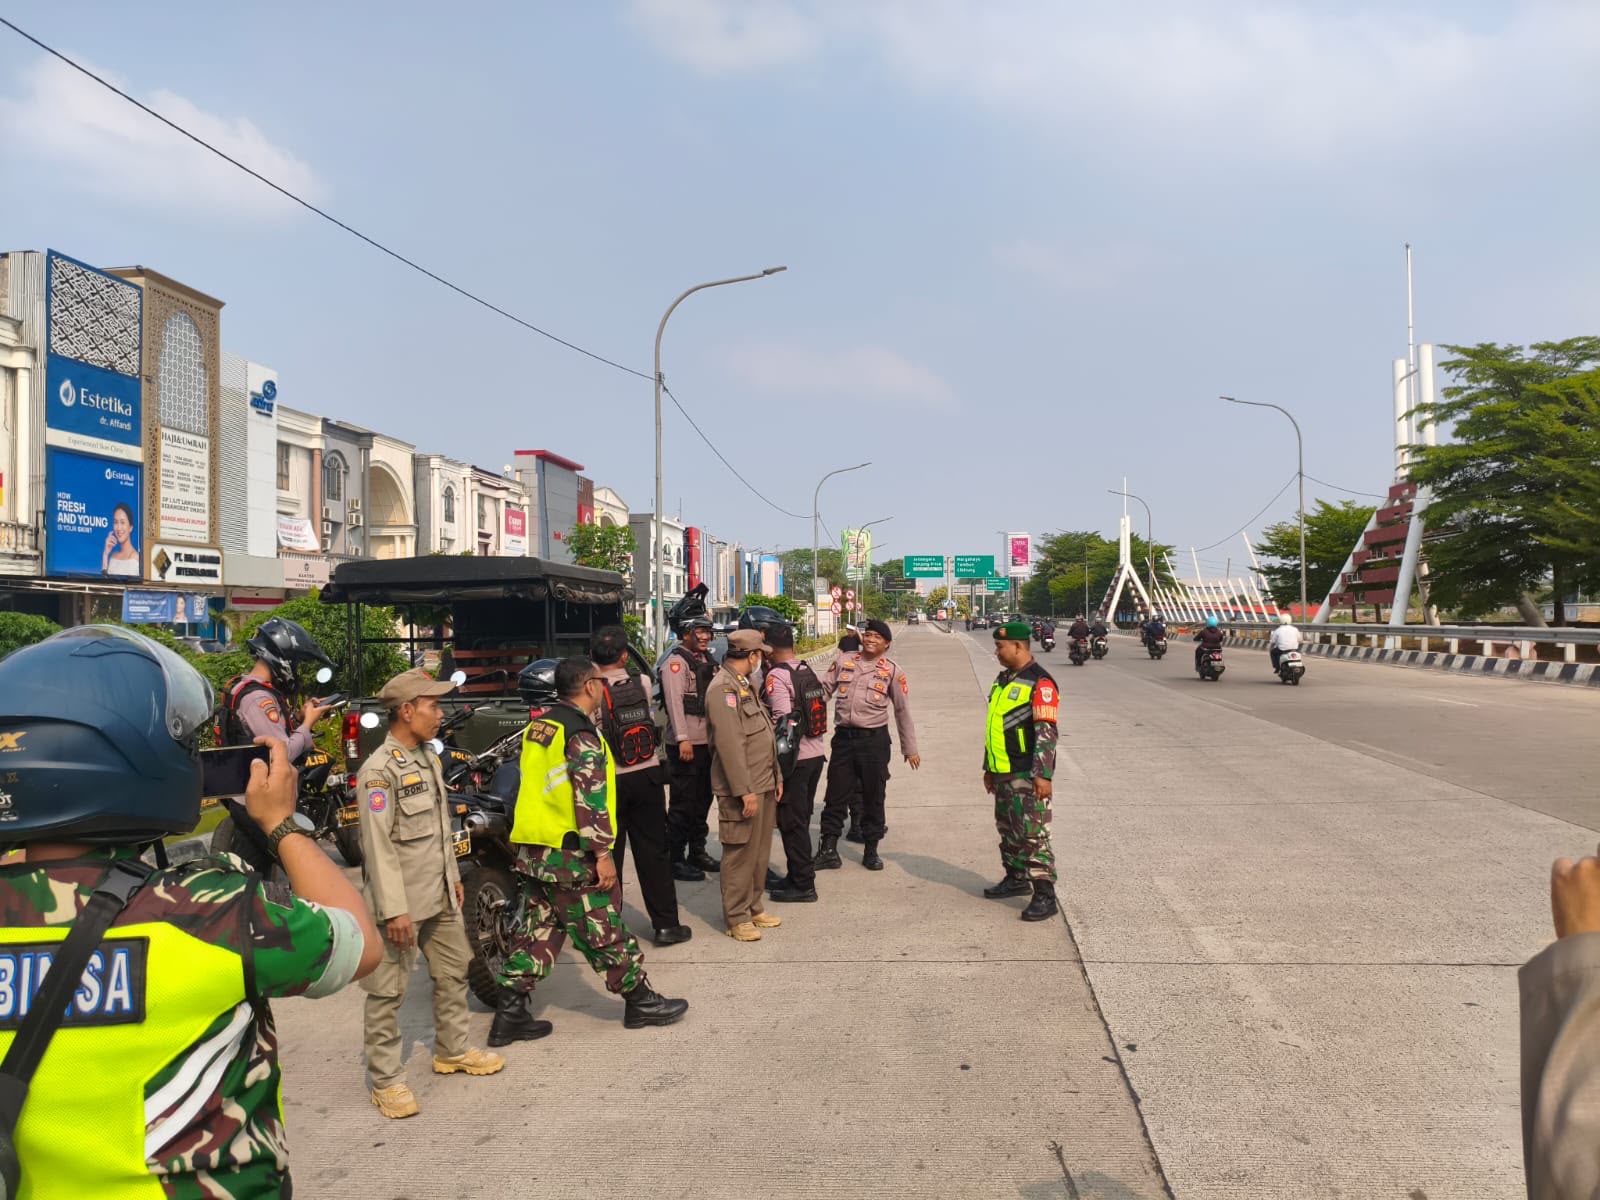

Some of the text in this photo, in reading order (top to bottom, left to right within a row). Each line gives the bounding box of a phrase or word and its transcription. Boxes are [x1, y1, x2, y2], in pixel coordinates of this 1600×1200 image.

[80, 387, 132, 417] Estetika
[99, 416, 132, 431] dr. Affandi
[112, 470, 135, 482] Estetika
[57, 491, 71, 500] HOW
[57, 499, 86, 514] FRESH
[57, 511, 109, 528] AND YOUNG
